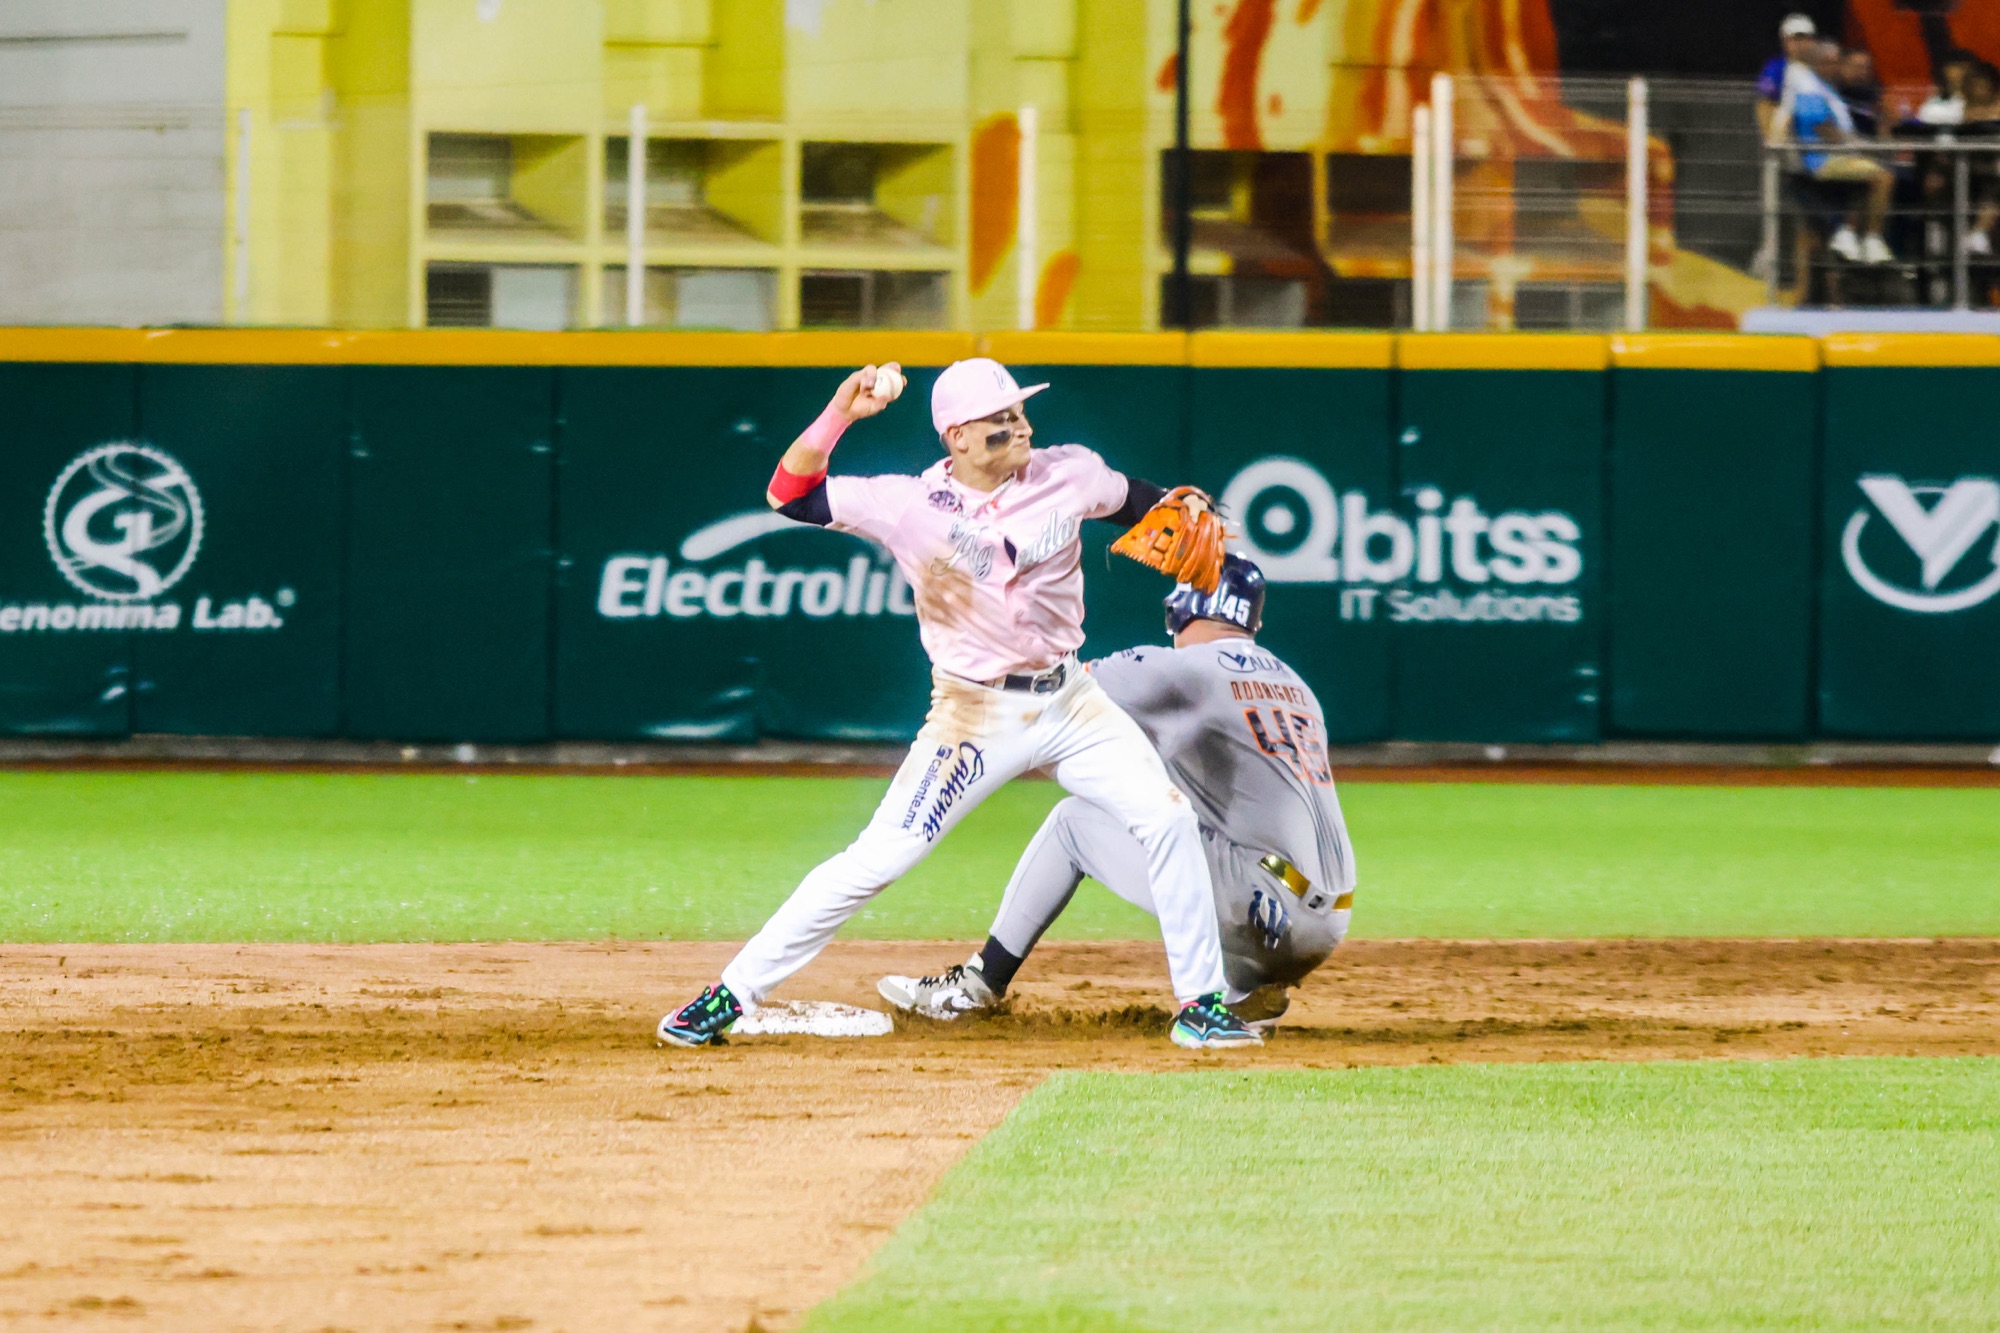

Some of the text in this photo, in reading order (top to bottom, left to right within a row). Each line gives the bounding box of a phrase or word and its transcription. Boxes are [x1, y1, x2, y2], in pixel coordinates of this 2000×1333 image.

[1222, 455, 1583, 583] Qbitss
[597, 553, 917, 617] Electrolit
[1222, 594, 1251, 627] 45
[1340, 589, 1582, 622] IT Solutions
[901, 758, 942, 831] caliente.mx
